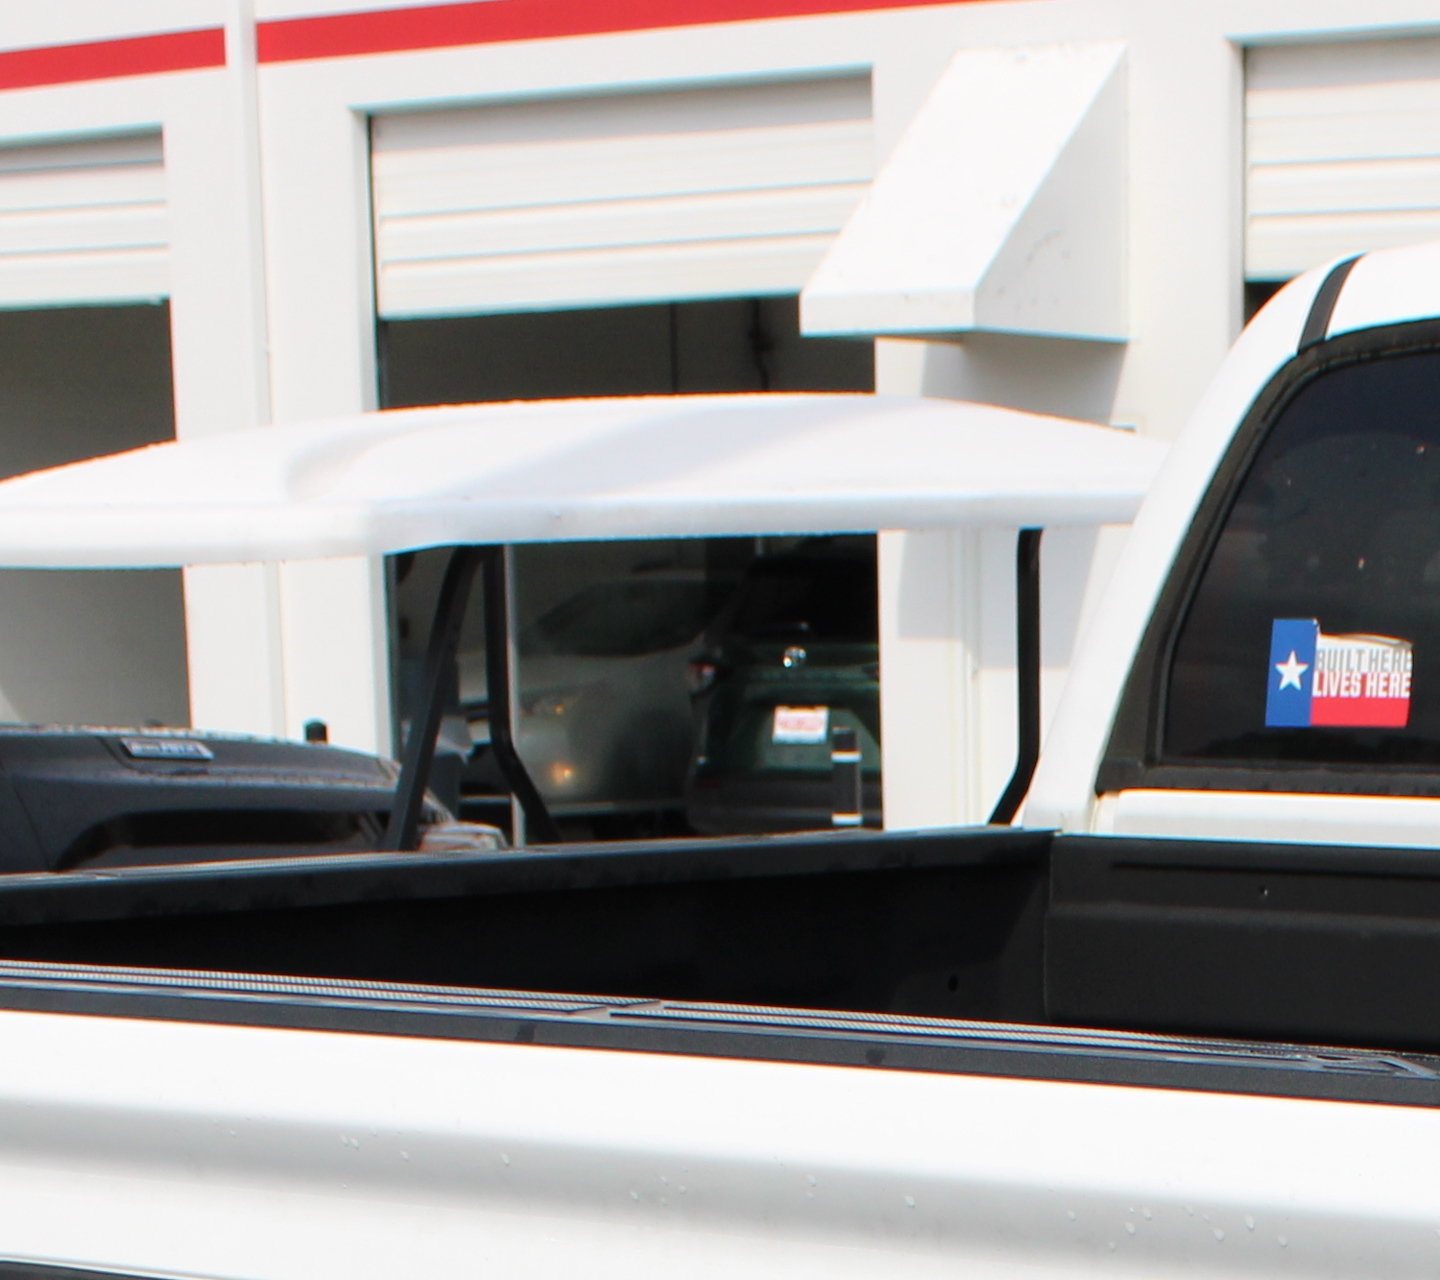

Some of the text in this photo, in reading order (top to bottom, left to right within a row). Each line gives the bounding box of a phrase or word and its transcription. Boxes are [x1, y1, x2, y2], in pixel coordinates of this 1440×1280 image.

[1315, 649, 1412, 672] BUILT HERE
[1312, 672, 1411, 698] LIVES HERE
